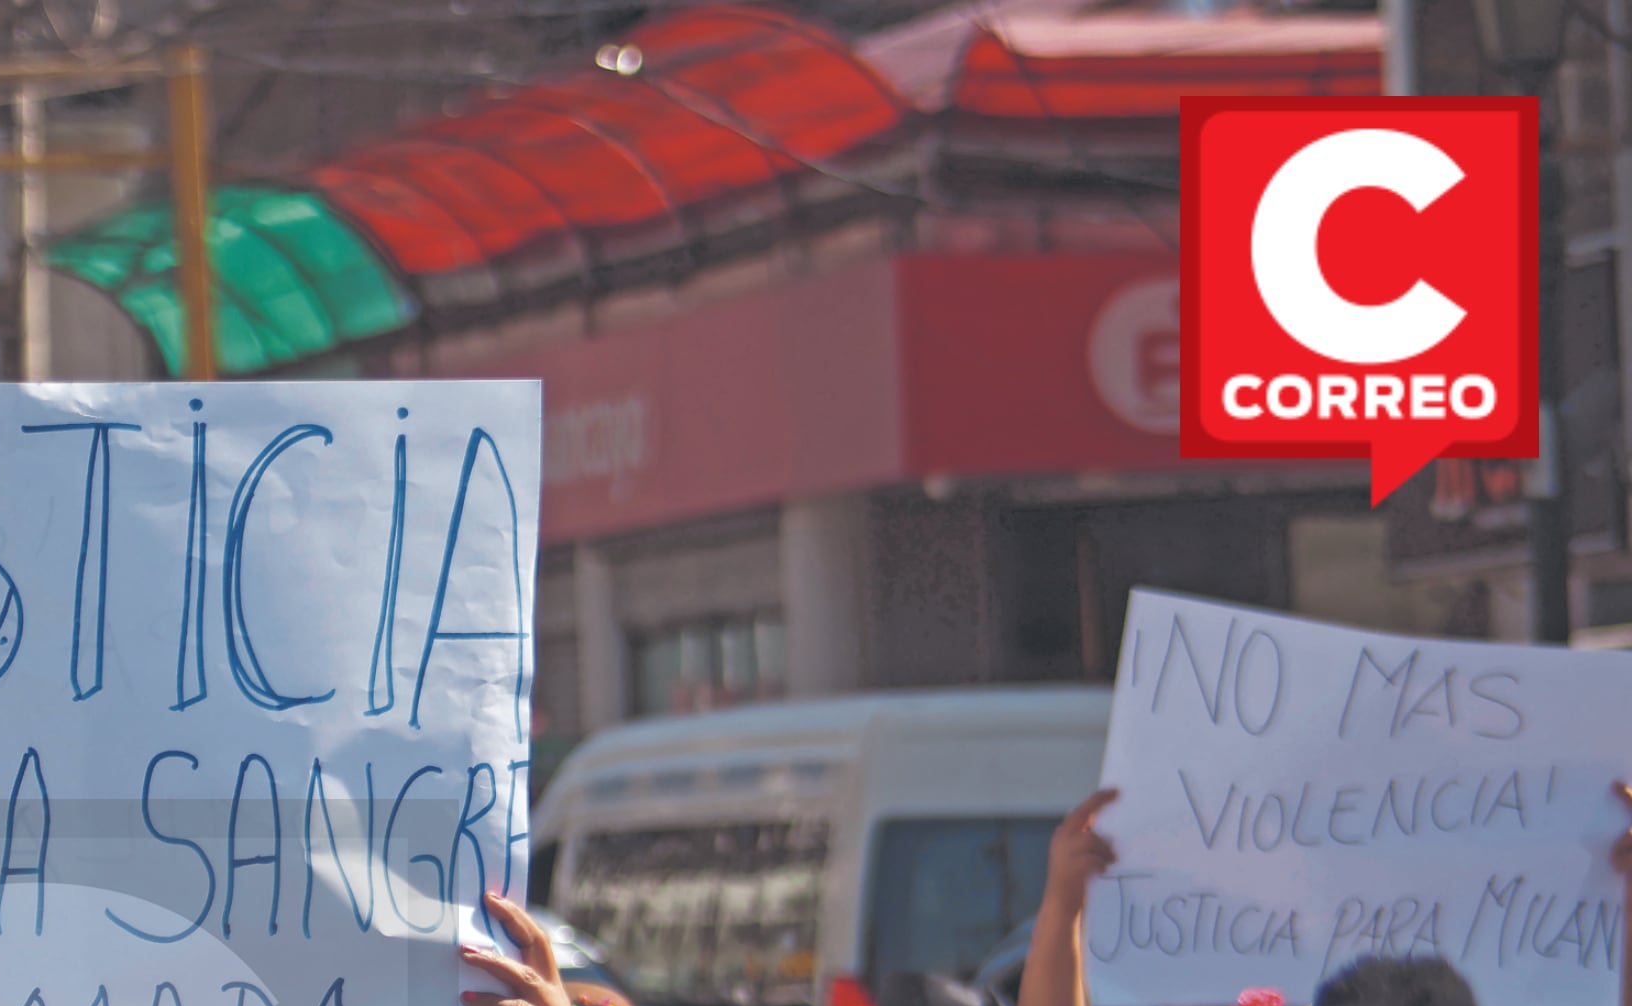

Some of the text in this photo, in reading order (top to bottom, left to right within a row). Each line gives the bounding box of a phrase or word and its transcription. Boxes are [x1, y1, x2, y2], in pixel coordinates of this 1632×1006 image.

[1339, 647, 1526, 741] MAS
[1089, 874, 1300, 963] JUSTICIA
[1320, 895, 1441, 978] PARA
